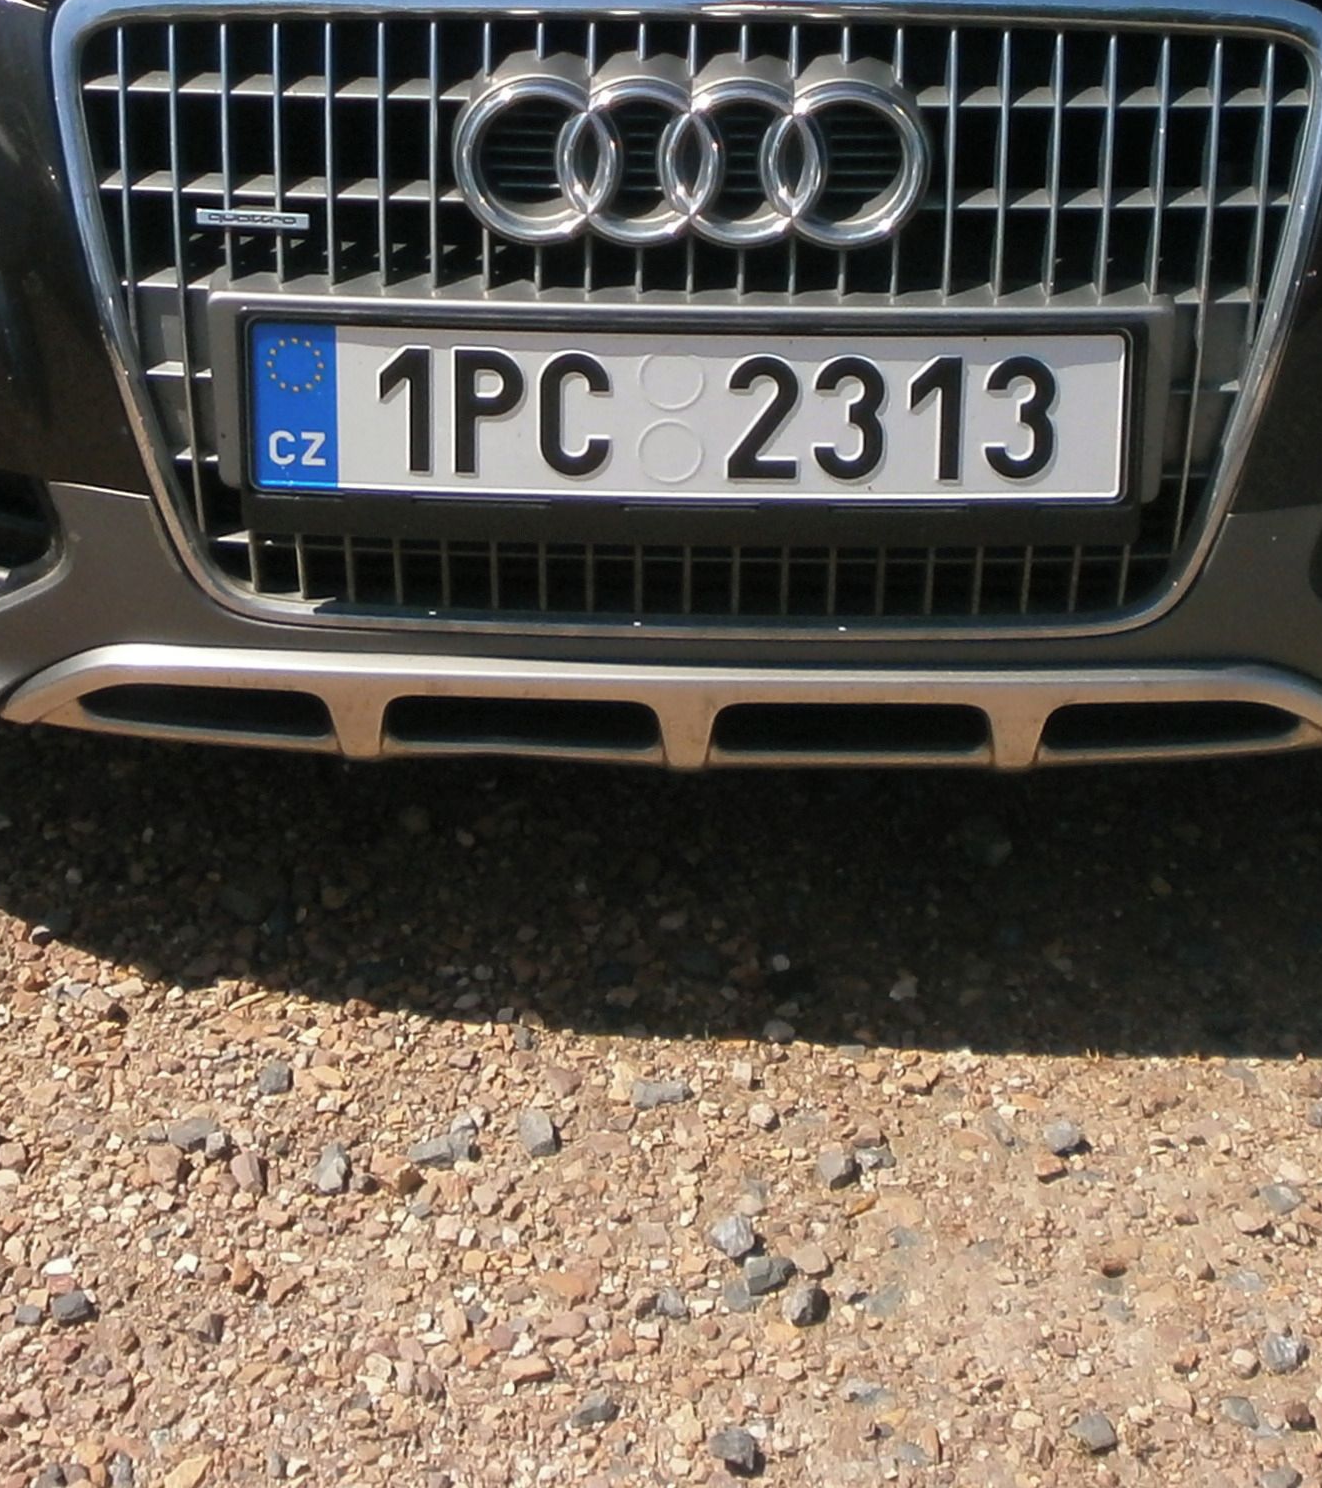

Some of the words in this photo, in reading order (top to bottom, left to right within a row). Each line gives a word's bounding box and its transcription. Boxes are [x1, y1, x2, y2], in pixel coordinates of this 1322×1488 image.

[208, 212, 297, 225] quattro
[379, 348, 611, 477] 1PC
[727, 355, 1057, 481] 2313
[268, 430, 327, 467] CZ
